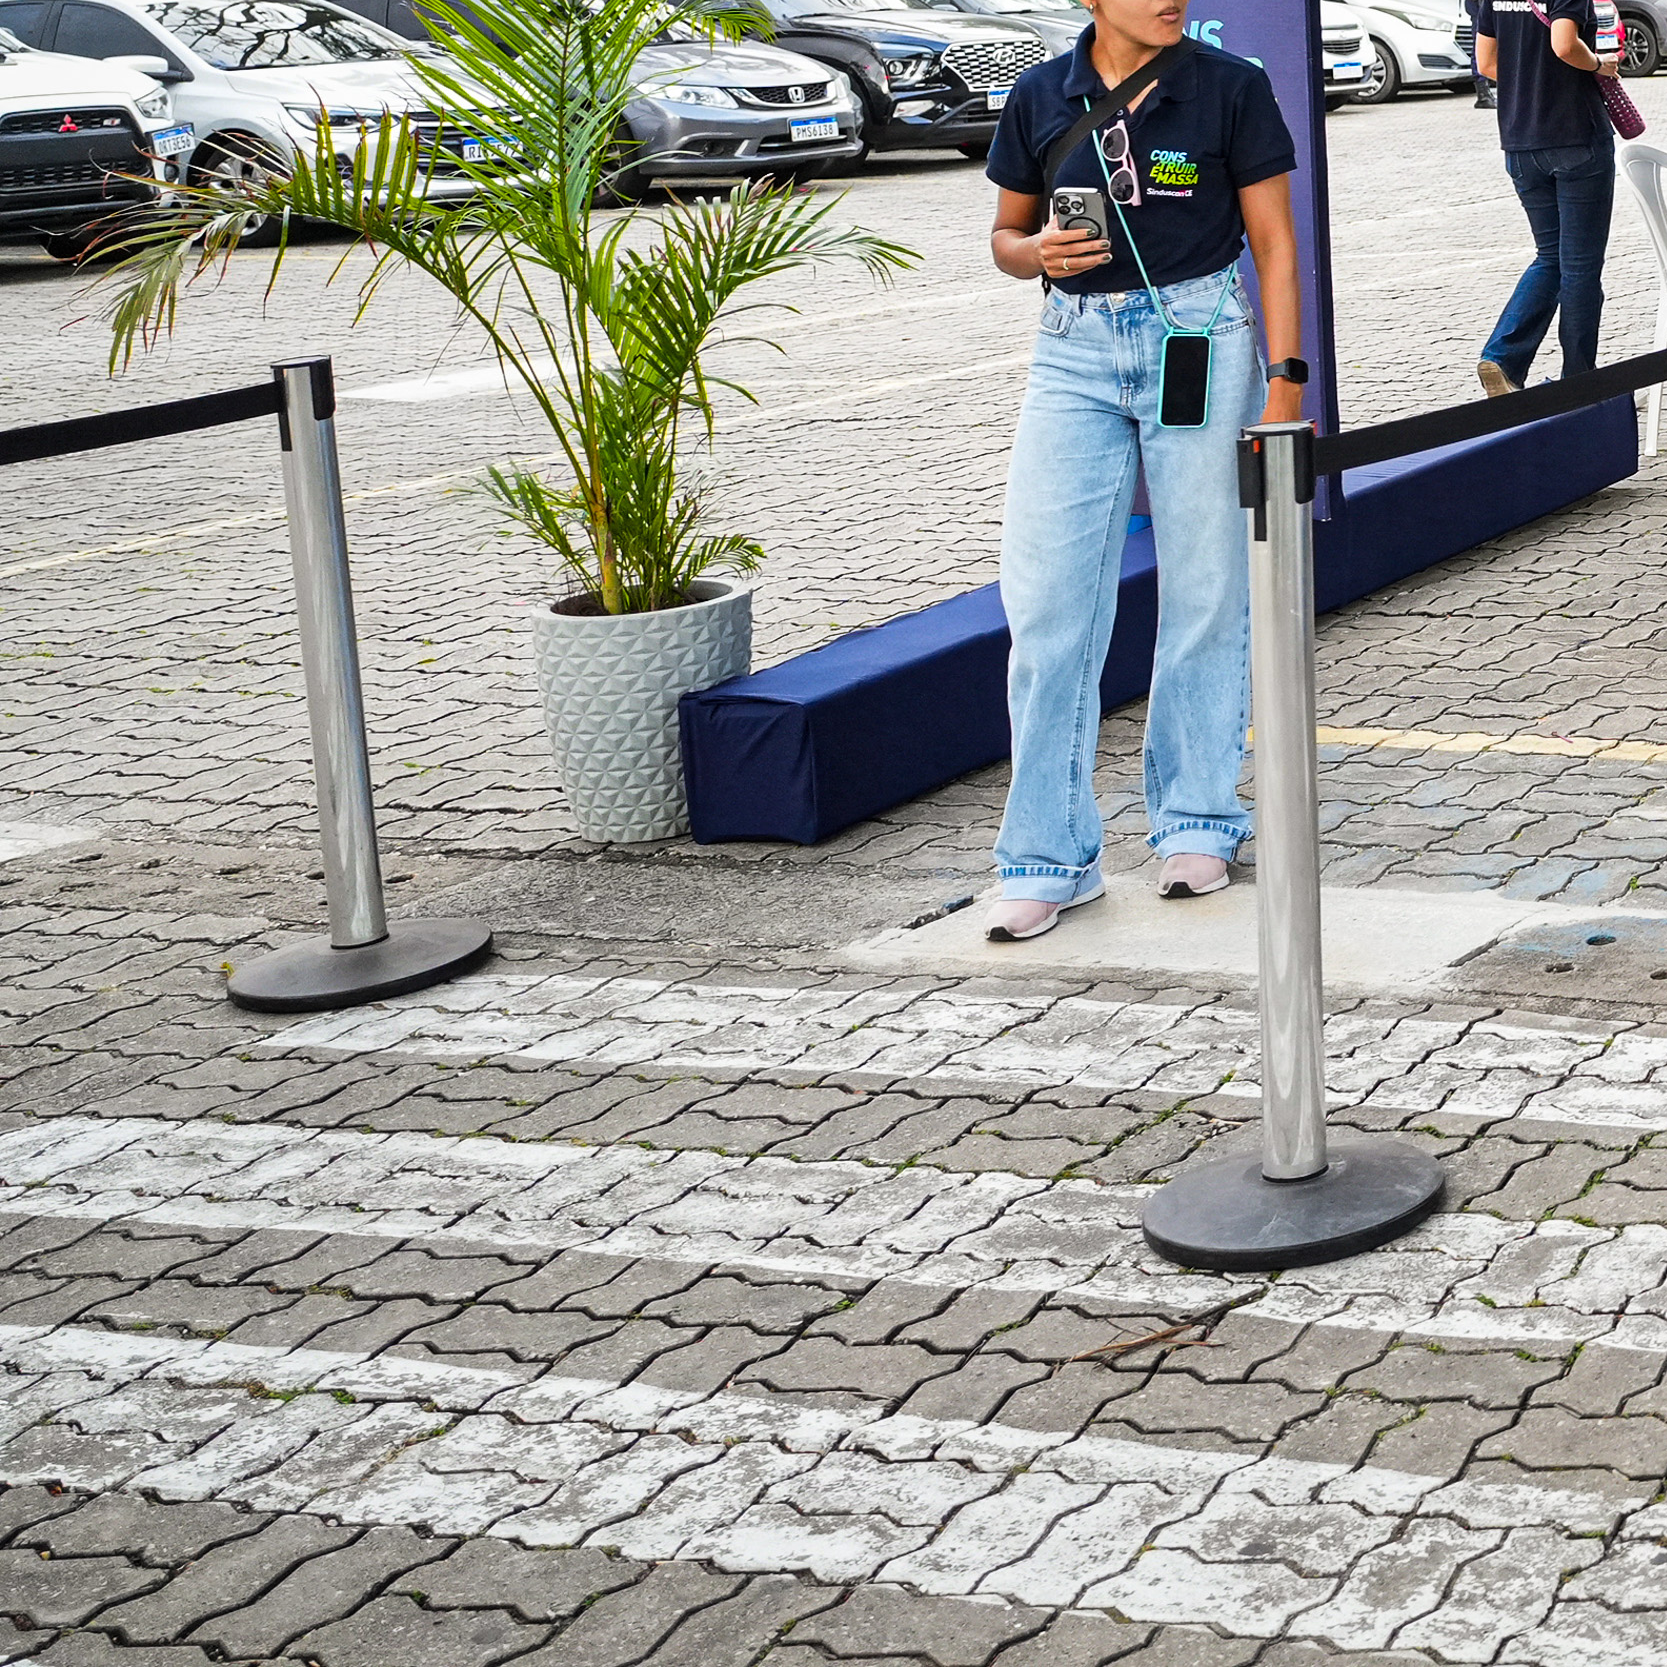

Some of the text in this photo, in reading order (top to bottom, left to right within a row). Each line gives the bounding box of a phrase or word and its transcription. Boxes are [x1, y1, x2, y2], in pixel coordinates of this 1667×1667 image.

[796, 124, 834, 138] PMS6138
[1150, 149, 1188, 163] CONS
[1155, 172, 1199, 185] MASSA
[1146, 187, 1193, 197] Sinduscon CE
